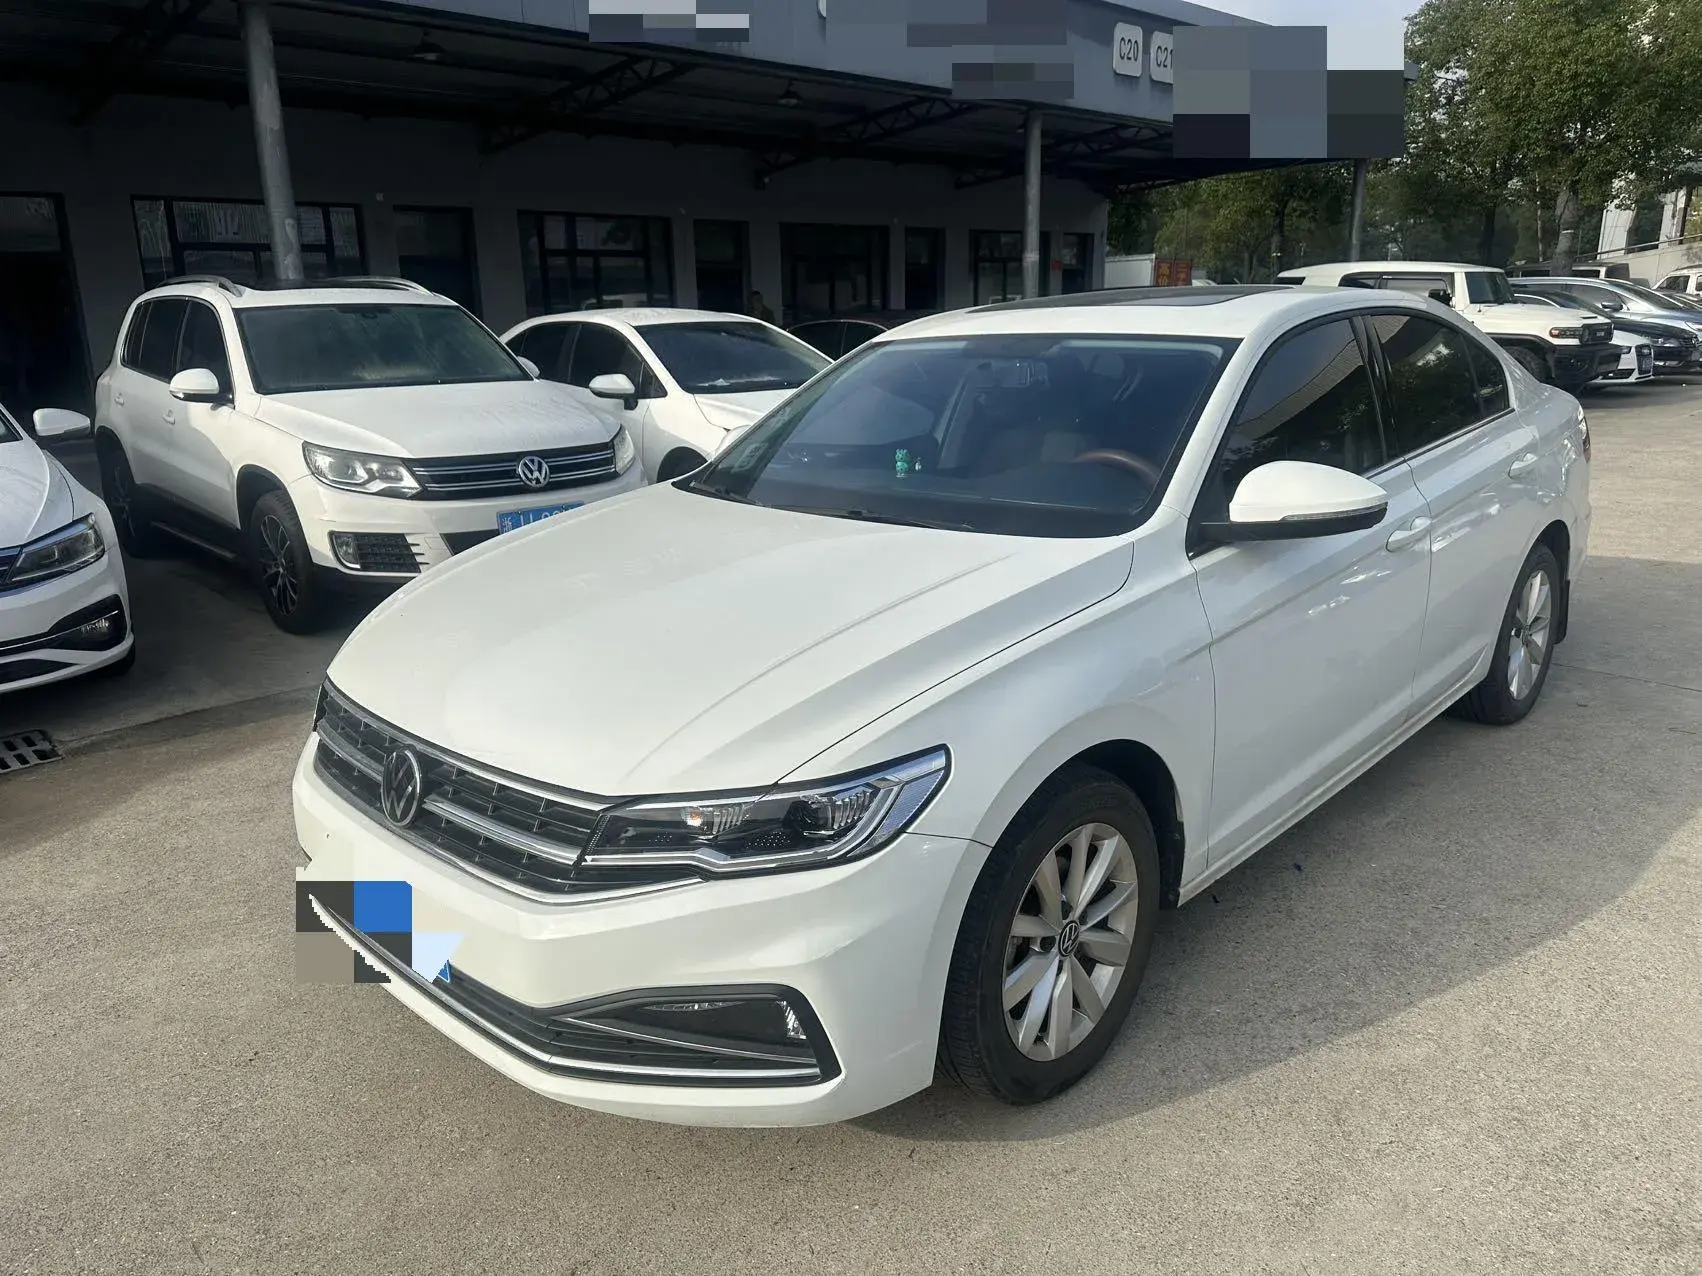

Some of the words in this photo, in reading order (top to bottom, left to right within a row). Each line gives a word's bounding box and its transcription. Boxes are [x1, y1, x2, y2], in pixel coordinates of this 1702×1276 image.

[1119, 36, 1139, 62] C20
[1156, 45, 1173, 69] C21
[519, 456, 550, 488] VW
